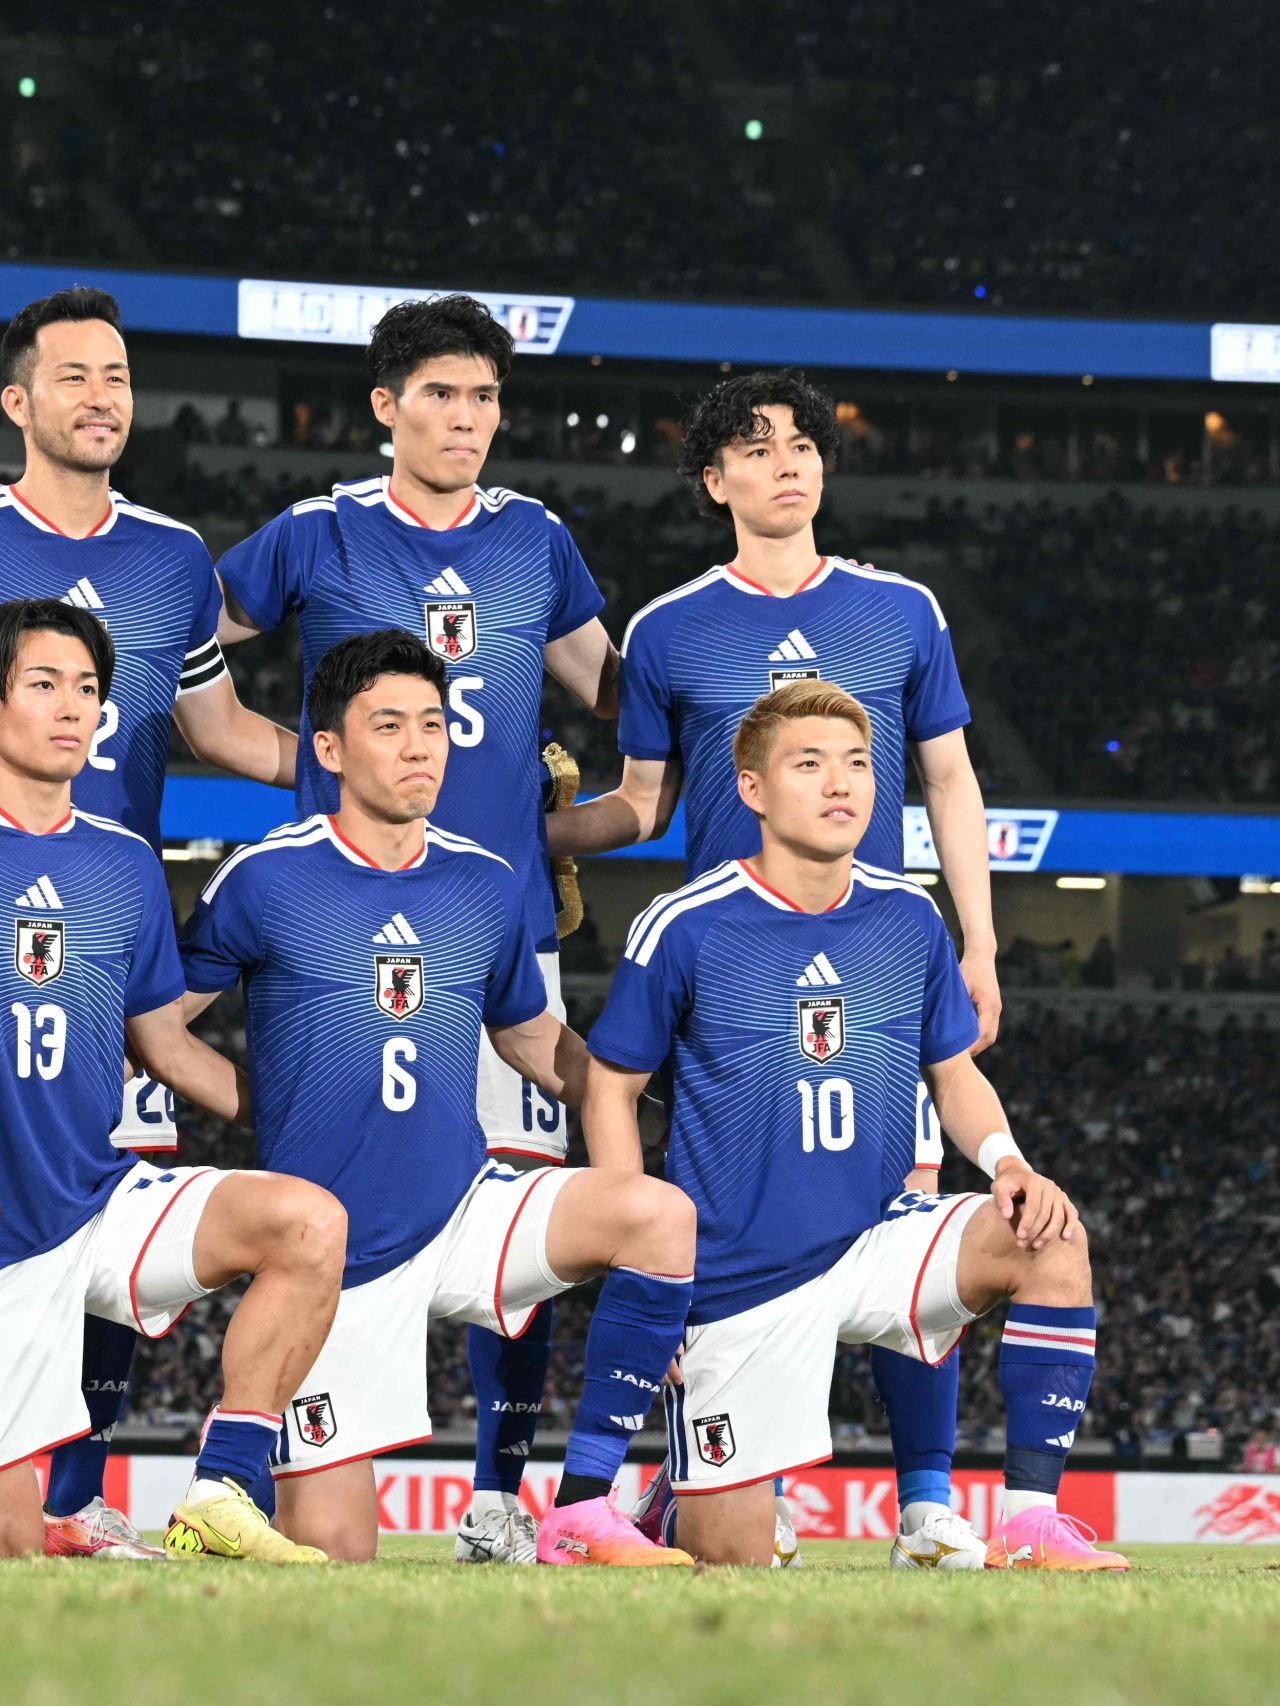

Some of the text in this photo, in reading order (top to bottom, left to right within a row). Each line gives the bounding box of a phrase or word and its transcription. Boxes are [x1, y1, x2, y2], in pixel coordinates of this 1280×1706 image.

[442, 644, 464, 653] JFA
[449, 676, 485, 748] 5
[87, 700, 120, 772] 2
[27, 921, 53, 929] JAPAN
[27, 965, 49, 976] JFA
[388, 999, 410, 1009] JFA
[807, 1000, 832, 1008] JAPAN
[11, 1002, 67, 1081] 13
[811, 1043, 831, 1054] JFA
[382, 1037, 417, 1112] 6
[797, 1077, 855, 1153] 10
[85, 1379, 129, 1393] JAP
[609, 1370, 661, 1393] JAPA
[301, 1395, 321, 1404] JAPAN
[1040, 1393, 1087, 1414] JAP
[701, 1416, 721, 1424] JAPAN
[309, 1430, 328, 1441] JFA
[377, 1474, 557, 1532] KIRN
